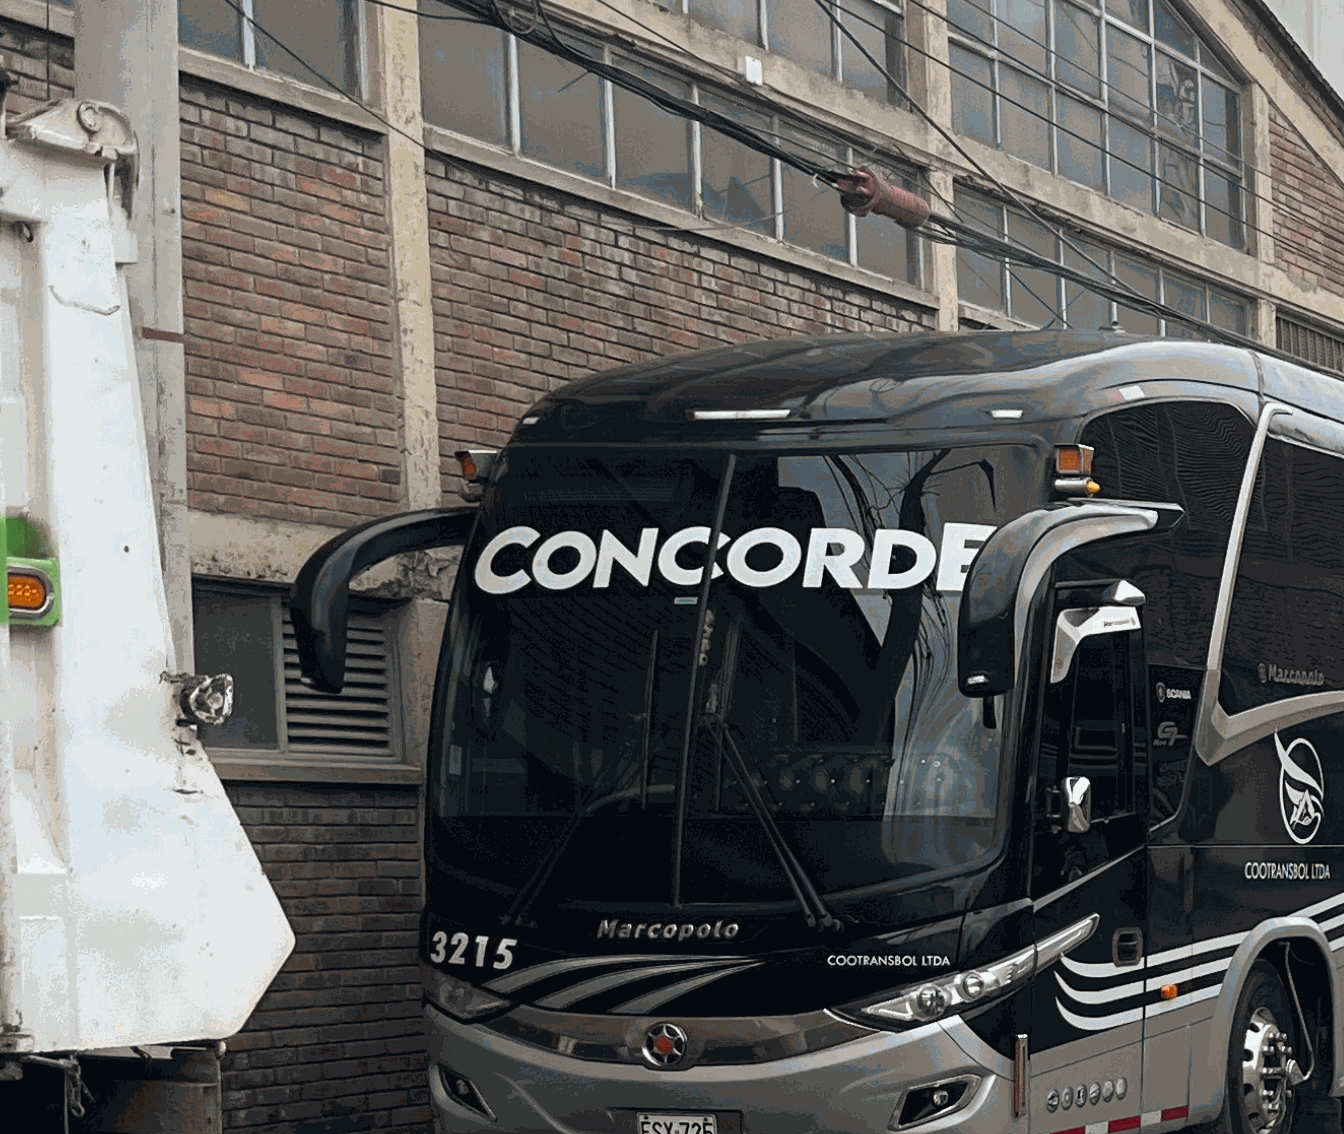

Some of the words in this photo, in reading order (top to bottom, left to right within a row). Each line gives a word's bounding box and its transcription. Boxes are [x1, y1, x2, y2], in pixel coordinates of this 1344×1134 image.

[1166, 688, 1192, 700] SCANIA
[1244, 861, 1310, 880] COOTRANSBOL
[1311, 862, 1331, 880] LTDA
[596, 919, 740, 942] Marcopolo
[430, 931, 519, 970] 3215
[827, 955, 918, 967] COOTRANSBOL
[921, 955, 951, 966] LTDA
